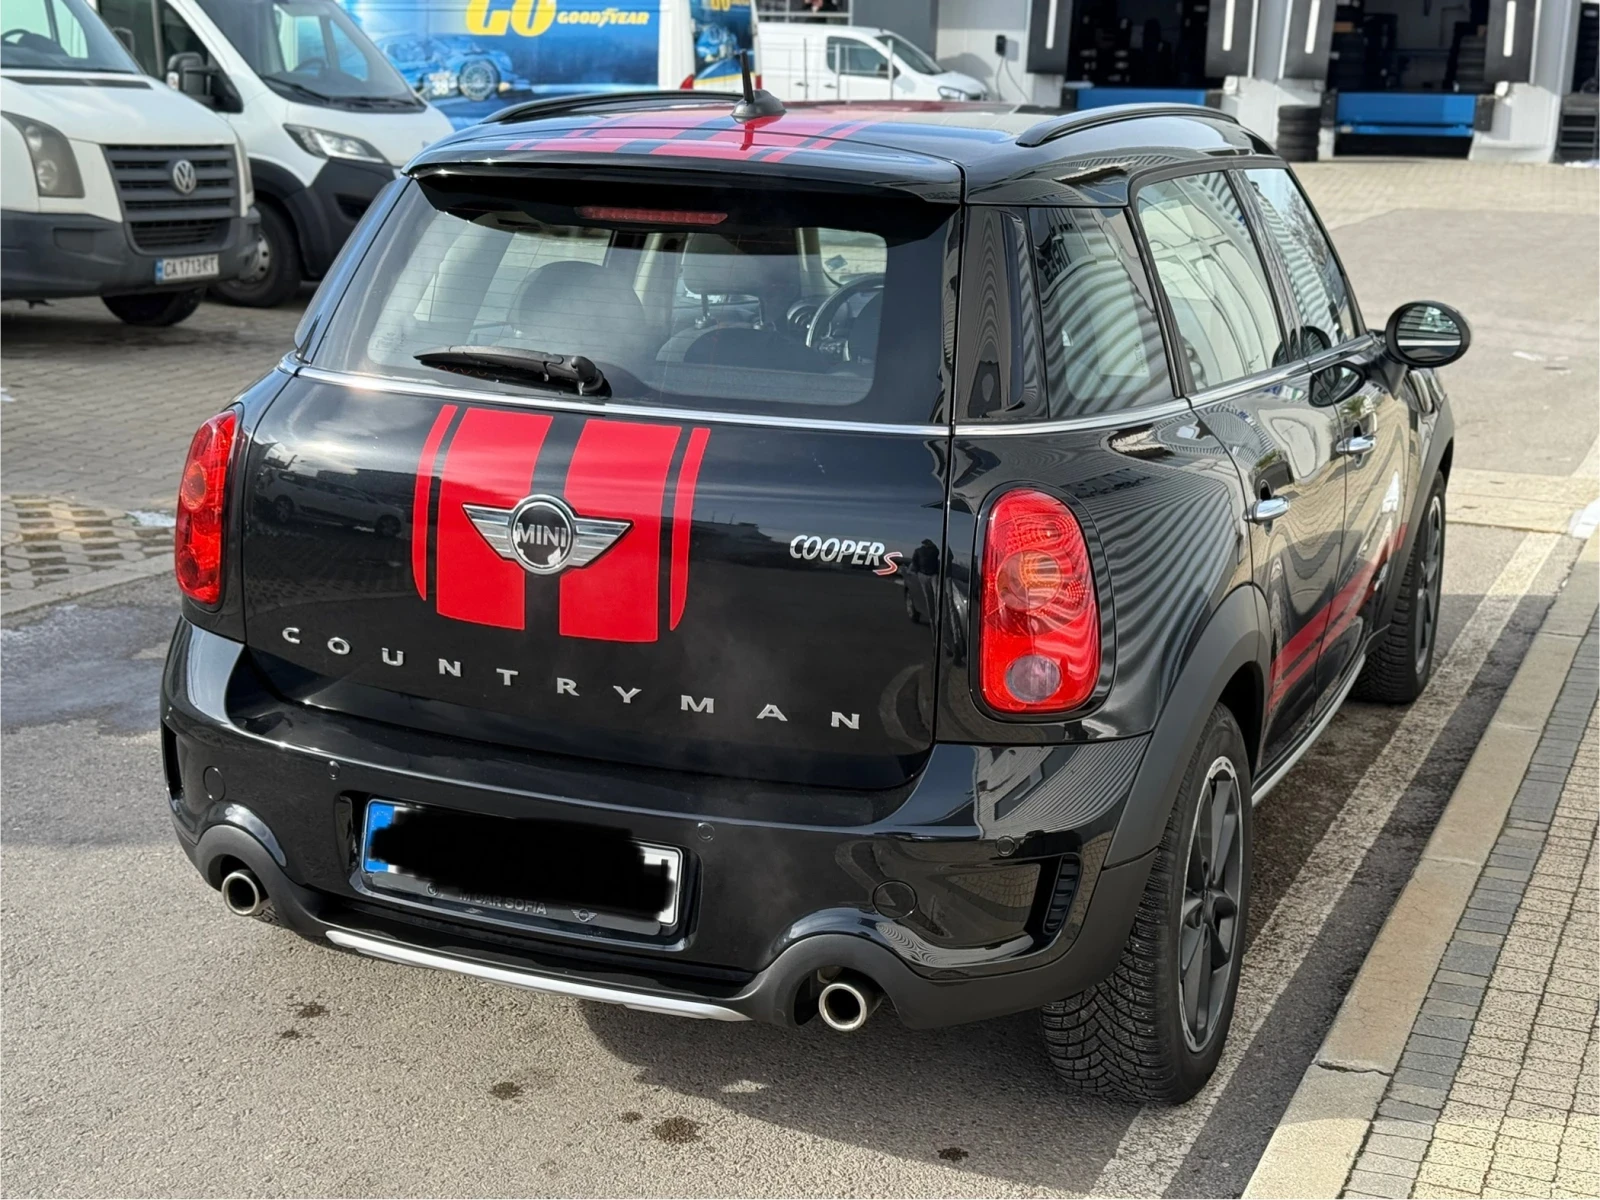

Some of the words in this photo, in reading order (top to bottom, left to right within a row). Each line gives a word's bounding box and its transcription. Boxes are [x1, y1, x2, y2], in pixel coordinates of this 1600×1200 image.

[557, 8, 650, 28] GOODYEAR
[516, 522, 567, 547] MINI
[789, 534, 885, 566] COOPER
[872, 551, 903, 575] S
[282, 627, 860, 730] COUNTRYMAN
[504, 897, 548, 915] SOFIA
